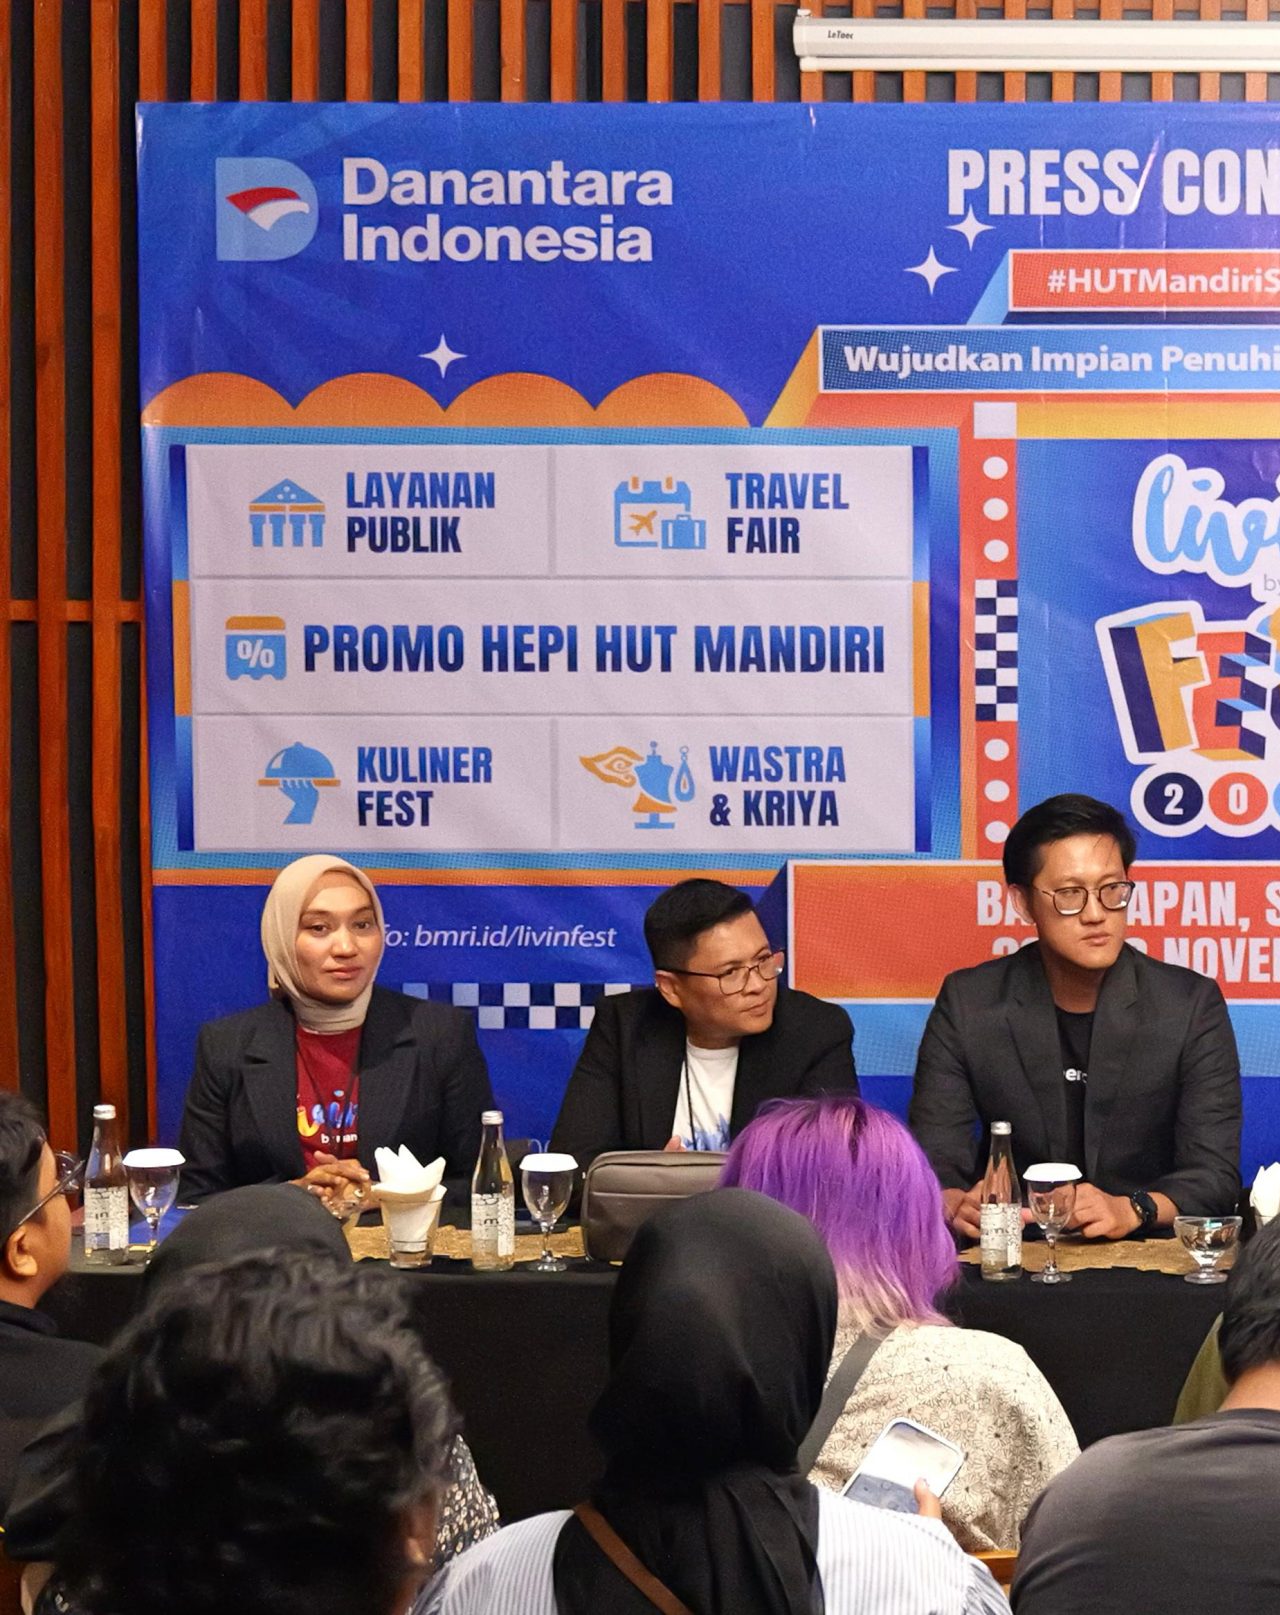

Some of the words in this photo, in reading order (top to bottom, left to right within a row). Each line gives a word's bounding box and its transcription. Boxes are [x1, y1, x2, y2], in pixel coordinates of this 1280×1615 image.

[343, 157, 673, 205] Danantara
[949, 149, 1141, 215] PRESS
[343, 213, 653, 262] Indonesia
[844, 345, 1023, 378] Wujudkan
[1032, 345, 1152, 378] Impian
[1162, 345, 1280, 373] Penuhi
[346, 472, 496, 508] LAYANAN
[725, 472, 850, 510] TRAVEL
[347, 516, 463, 553] PUBLIK
[727, 517, 800, 554] FAIR
[304, 625, 465, 673] PROMO
[482, 625, 578, 673] HEPI
[594, 625, 678, 673] HUT
[695, 625, 886, 674] MANDIRI
[357, 747, 492, 784] KULINER
[708, 746, 846, 783] WASTRA
[358, 791, 434, 827] FEST
[710, 793, 732, 827] &
[742, 791, 840, 828] KRIYA
[414, 924, 618, 948] bmri.id/livinfest
